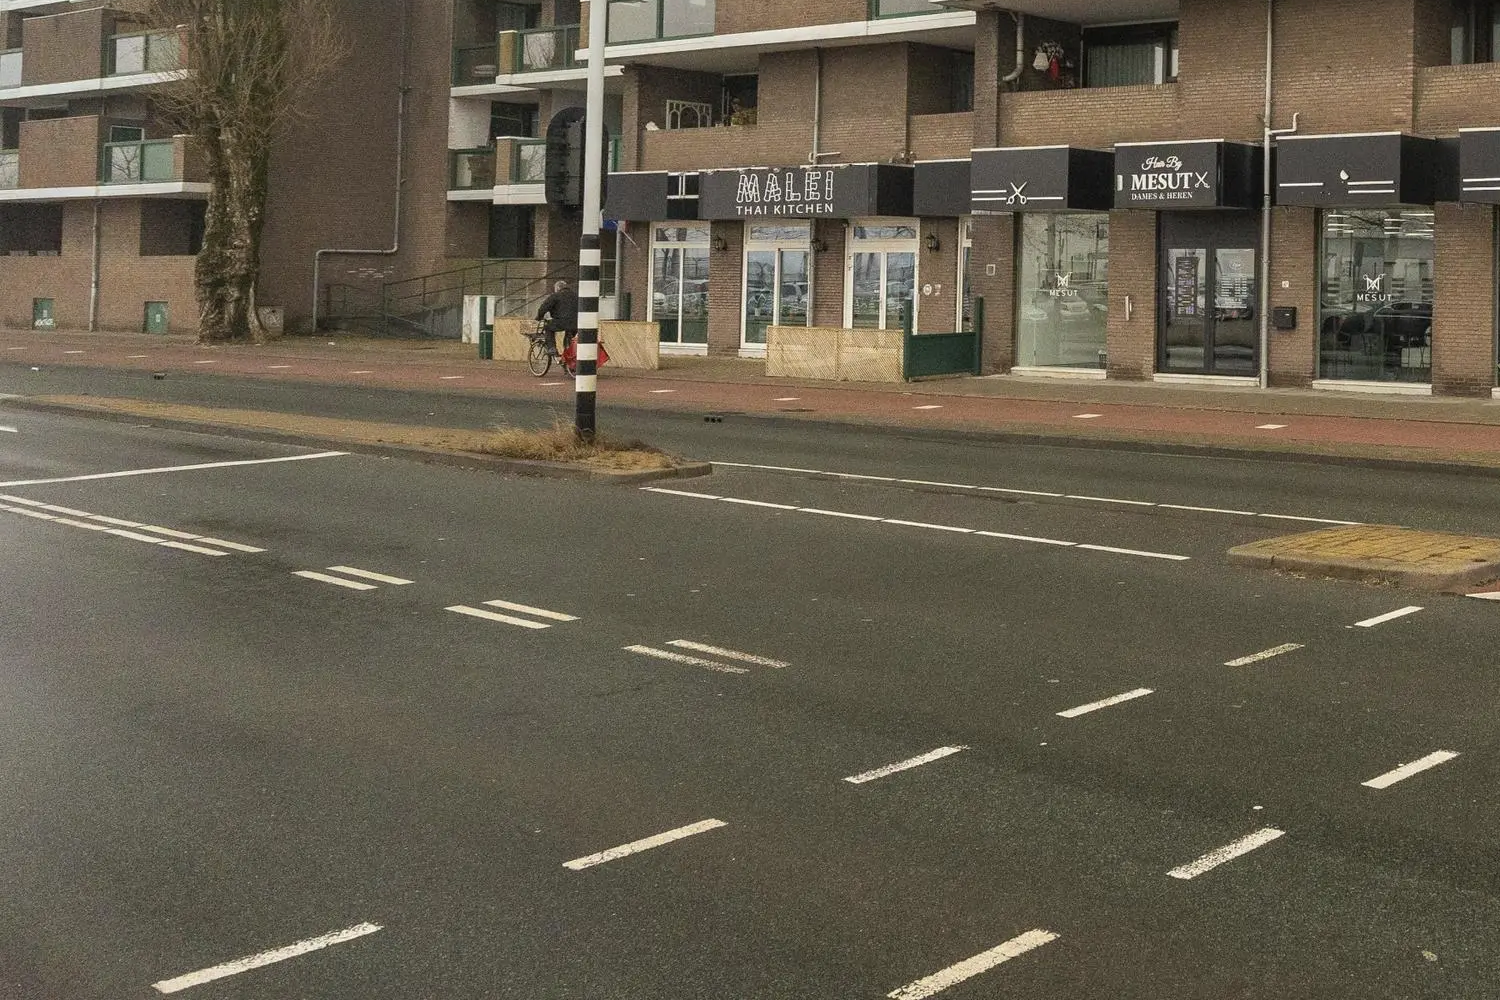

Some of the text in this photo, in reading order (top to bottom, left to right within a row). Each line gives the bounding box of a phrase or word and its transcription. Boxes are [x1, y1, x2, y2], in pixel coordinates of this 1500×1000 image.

[1141, 156, 1182, 171] Hair By
[736, 170, 833, 202] MALEI
[1131, 172, 1193, 191] MESUT
[1131, 191, 1193, 201] DAMES & HEREN
[736, 203, 834, 215] THAI KITCHEN
[1050, 289, 1078, 297] MESUT
[1357, 294, 1392, 302] MESUT
